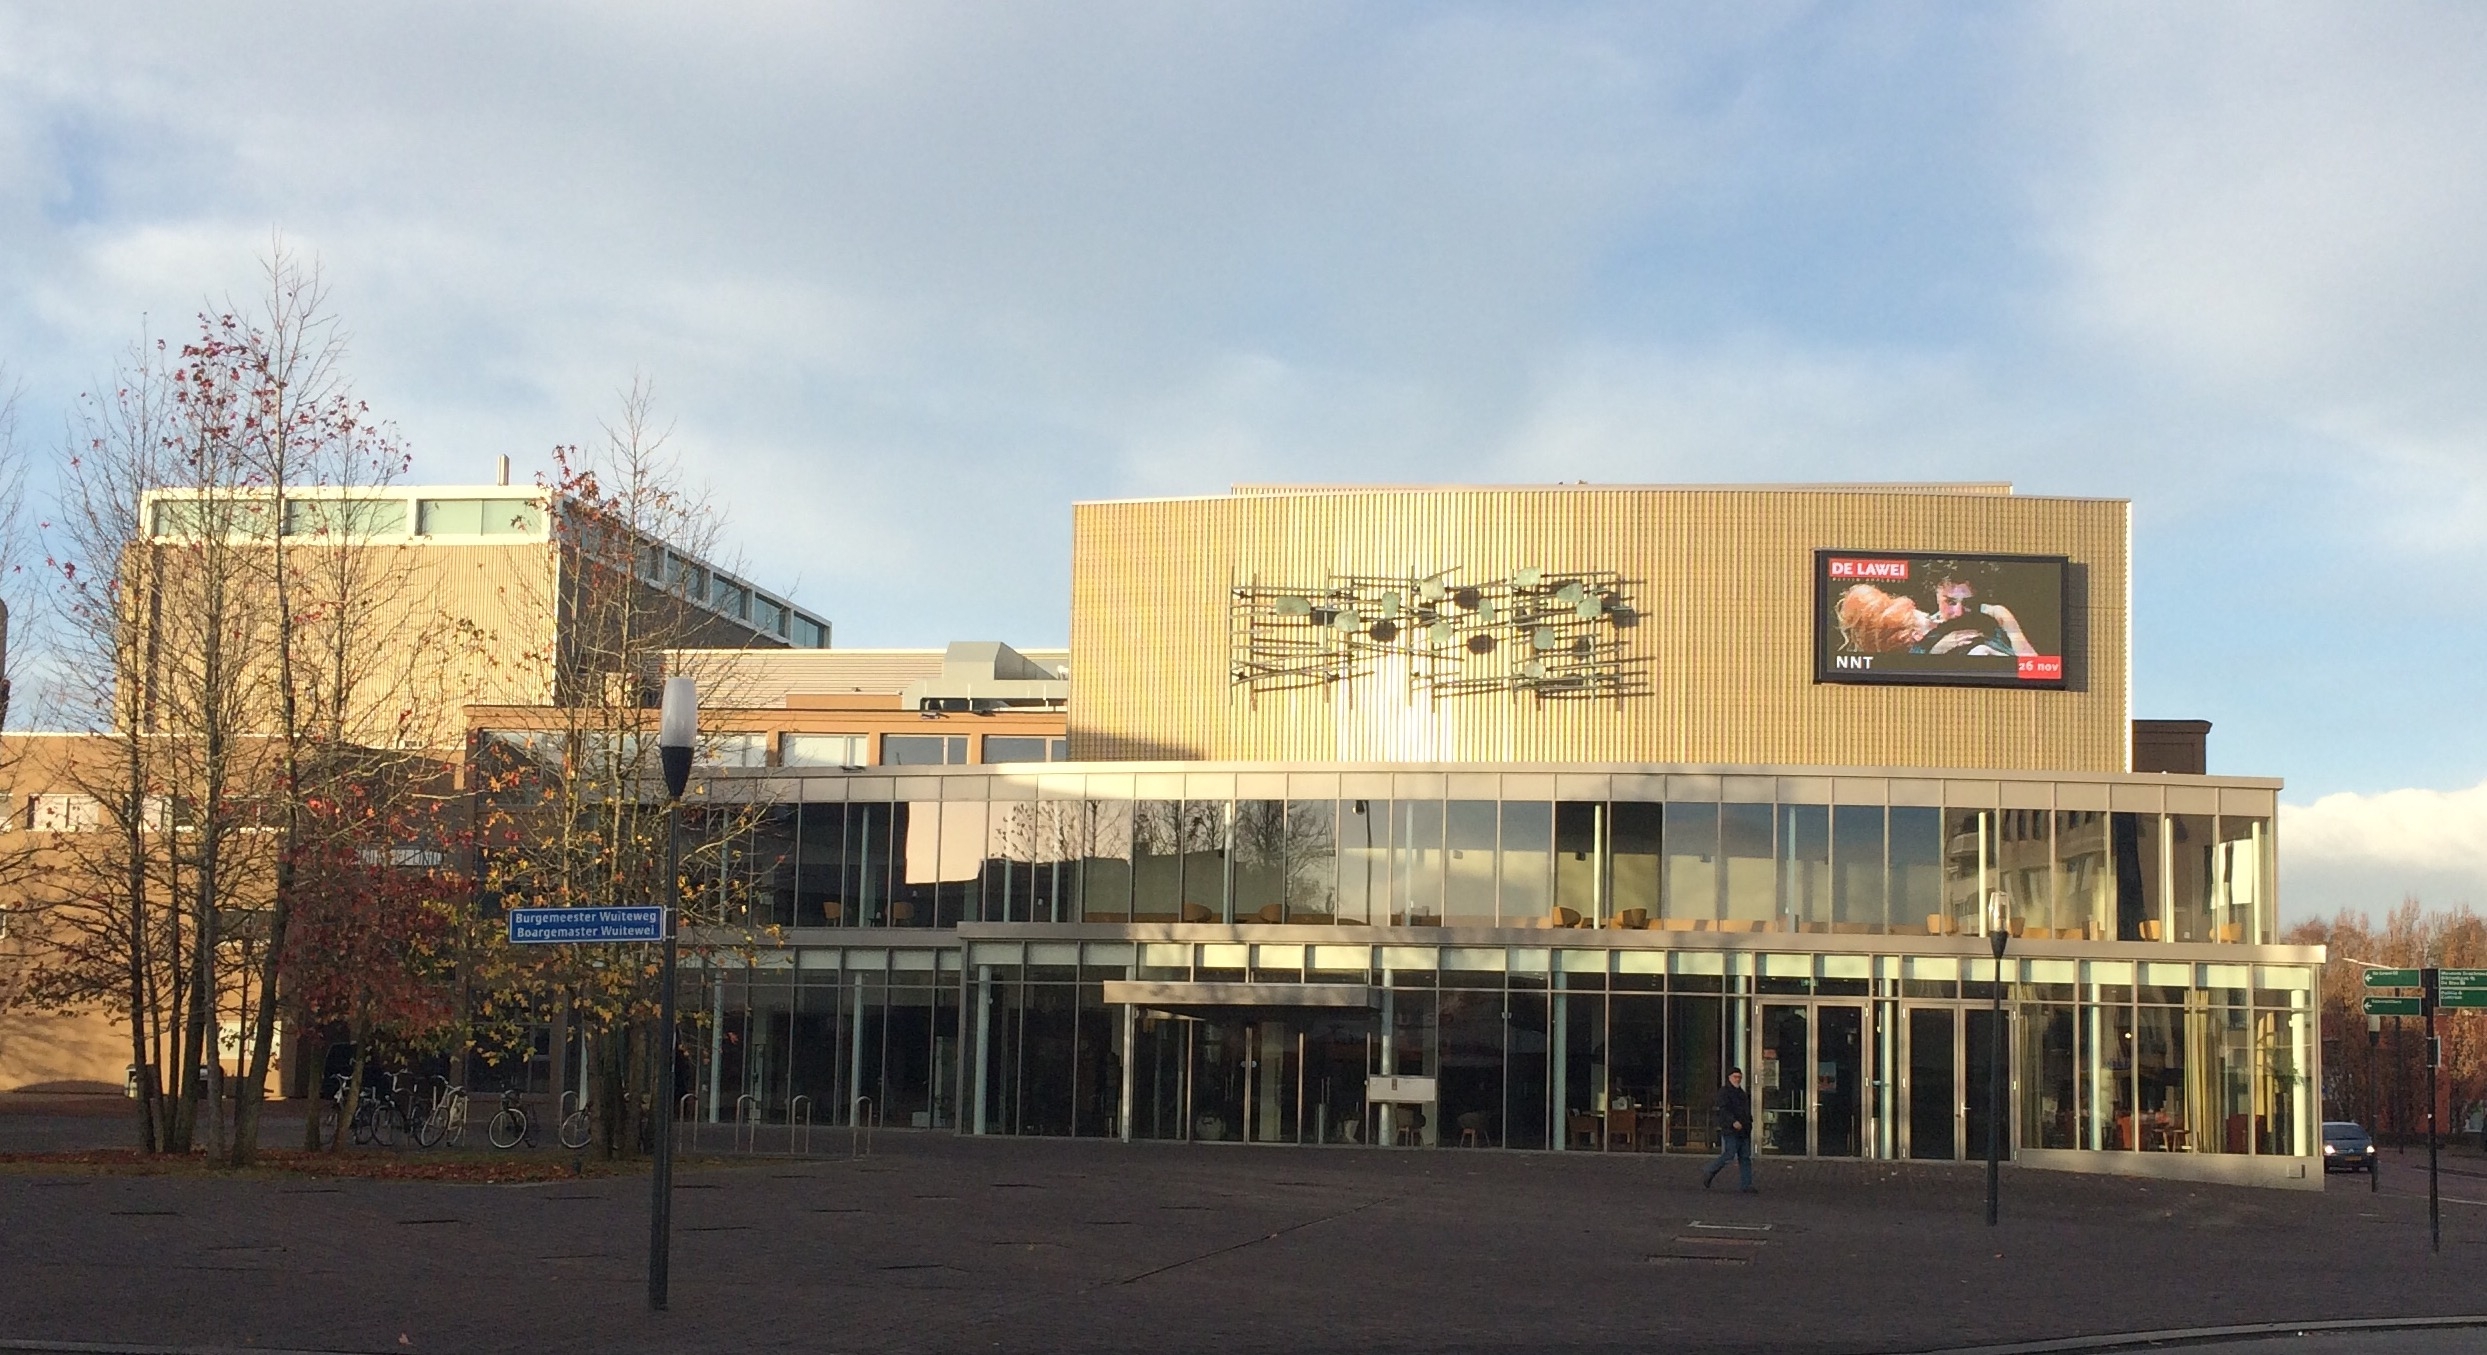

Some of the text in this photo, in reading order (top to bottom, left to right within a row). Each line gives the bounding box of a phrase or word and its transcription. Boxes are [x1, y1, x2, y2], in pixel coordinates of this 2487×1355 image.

[1832, 562, 1905, 576] DE LAWEI
[1836, 656, 1874, 669] NNT
[2018, 660, 2059, 671] 26 nov
[515, 911, 657, 925] Burgemeester Wuiteweg
[517, 925, 655, 939] Boargemaster Wuitewei
